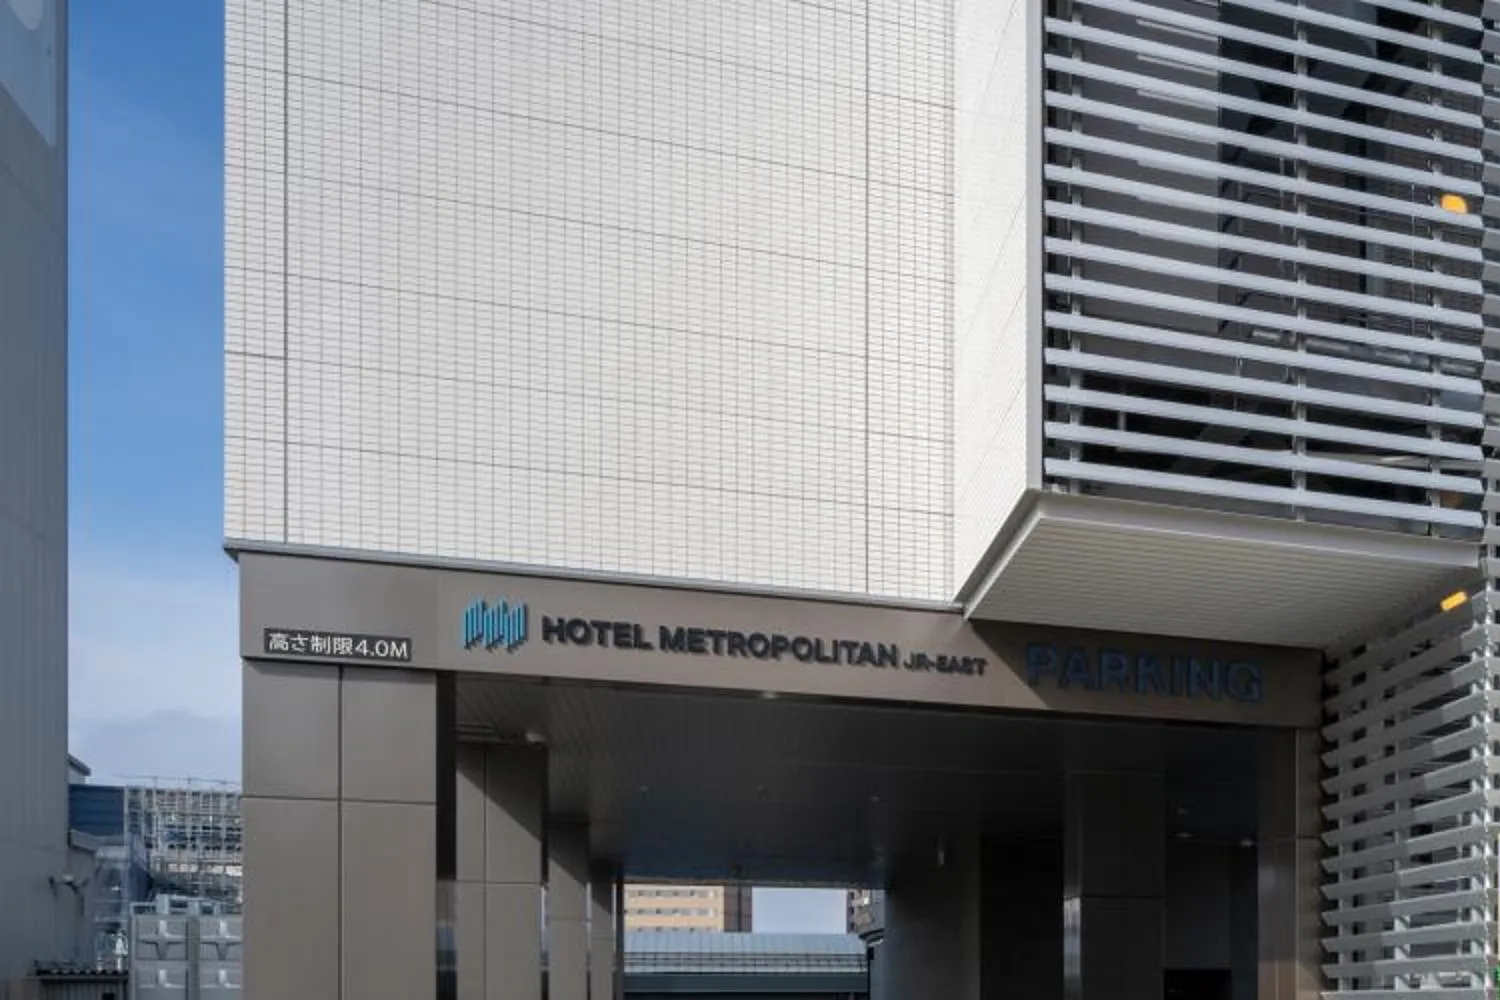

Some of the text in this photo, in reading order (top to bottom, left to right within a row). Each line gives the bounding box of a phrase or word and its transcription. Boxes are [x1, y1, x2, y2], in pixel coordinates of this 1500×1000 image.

[269, 633, 409, 659] 高さ制限4.0M
[541, 616, 988, 676] HOTEL METROPOLITAN JR-EAST
[1025, 642, 1264, 701] PARKING
